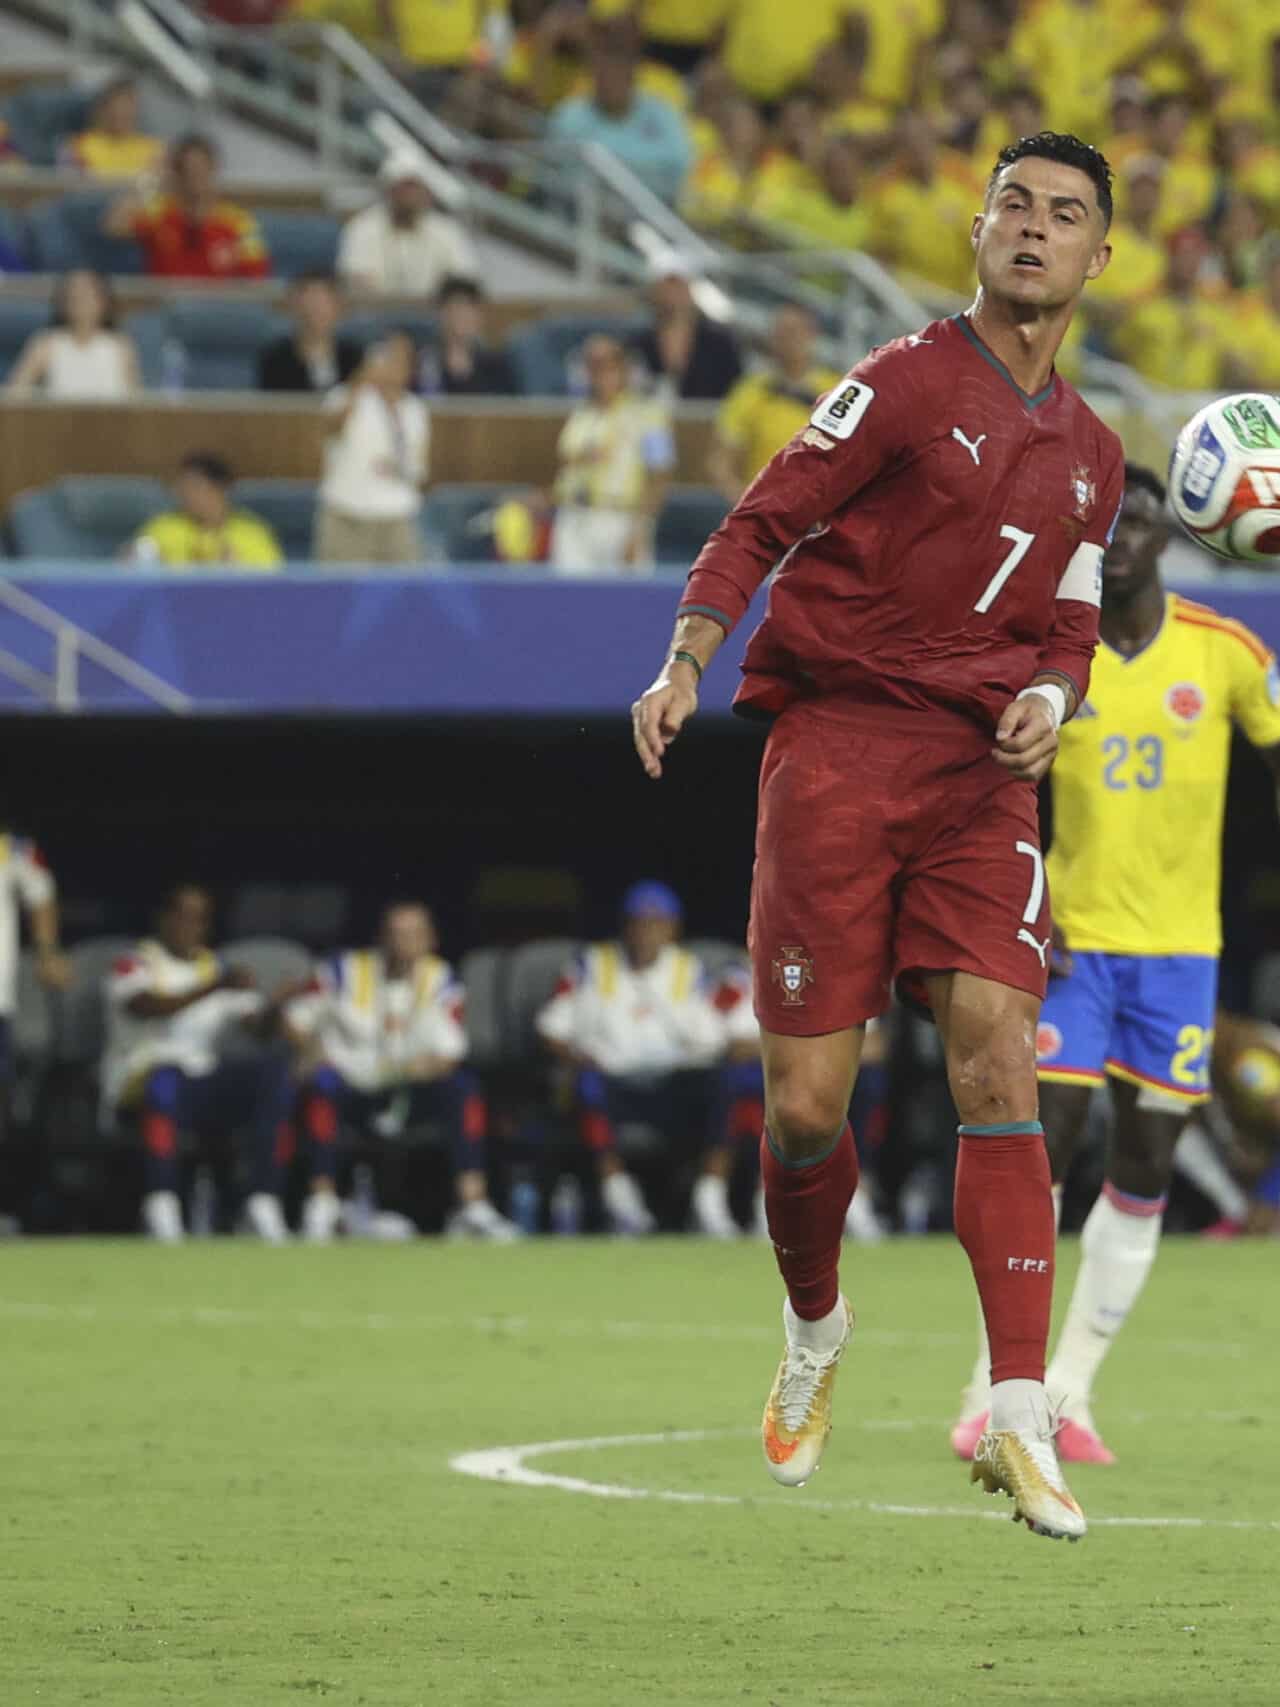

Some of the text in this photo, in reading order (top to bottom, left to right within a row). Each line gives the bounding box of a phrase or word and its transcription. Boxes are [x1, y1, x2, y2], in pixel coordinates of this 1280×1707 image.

[973, 524, 1036, 614] 7
[1102, 733, 1164, 791] 23
[1015, 840, 1045, 924] 7
[974, 1434, 1004, 1463] CR7
